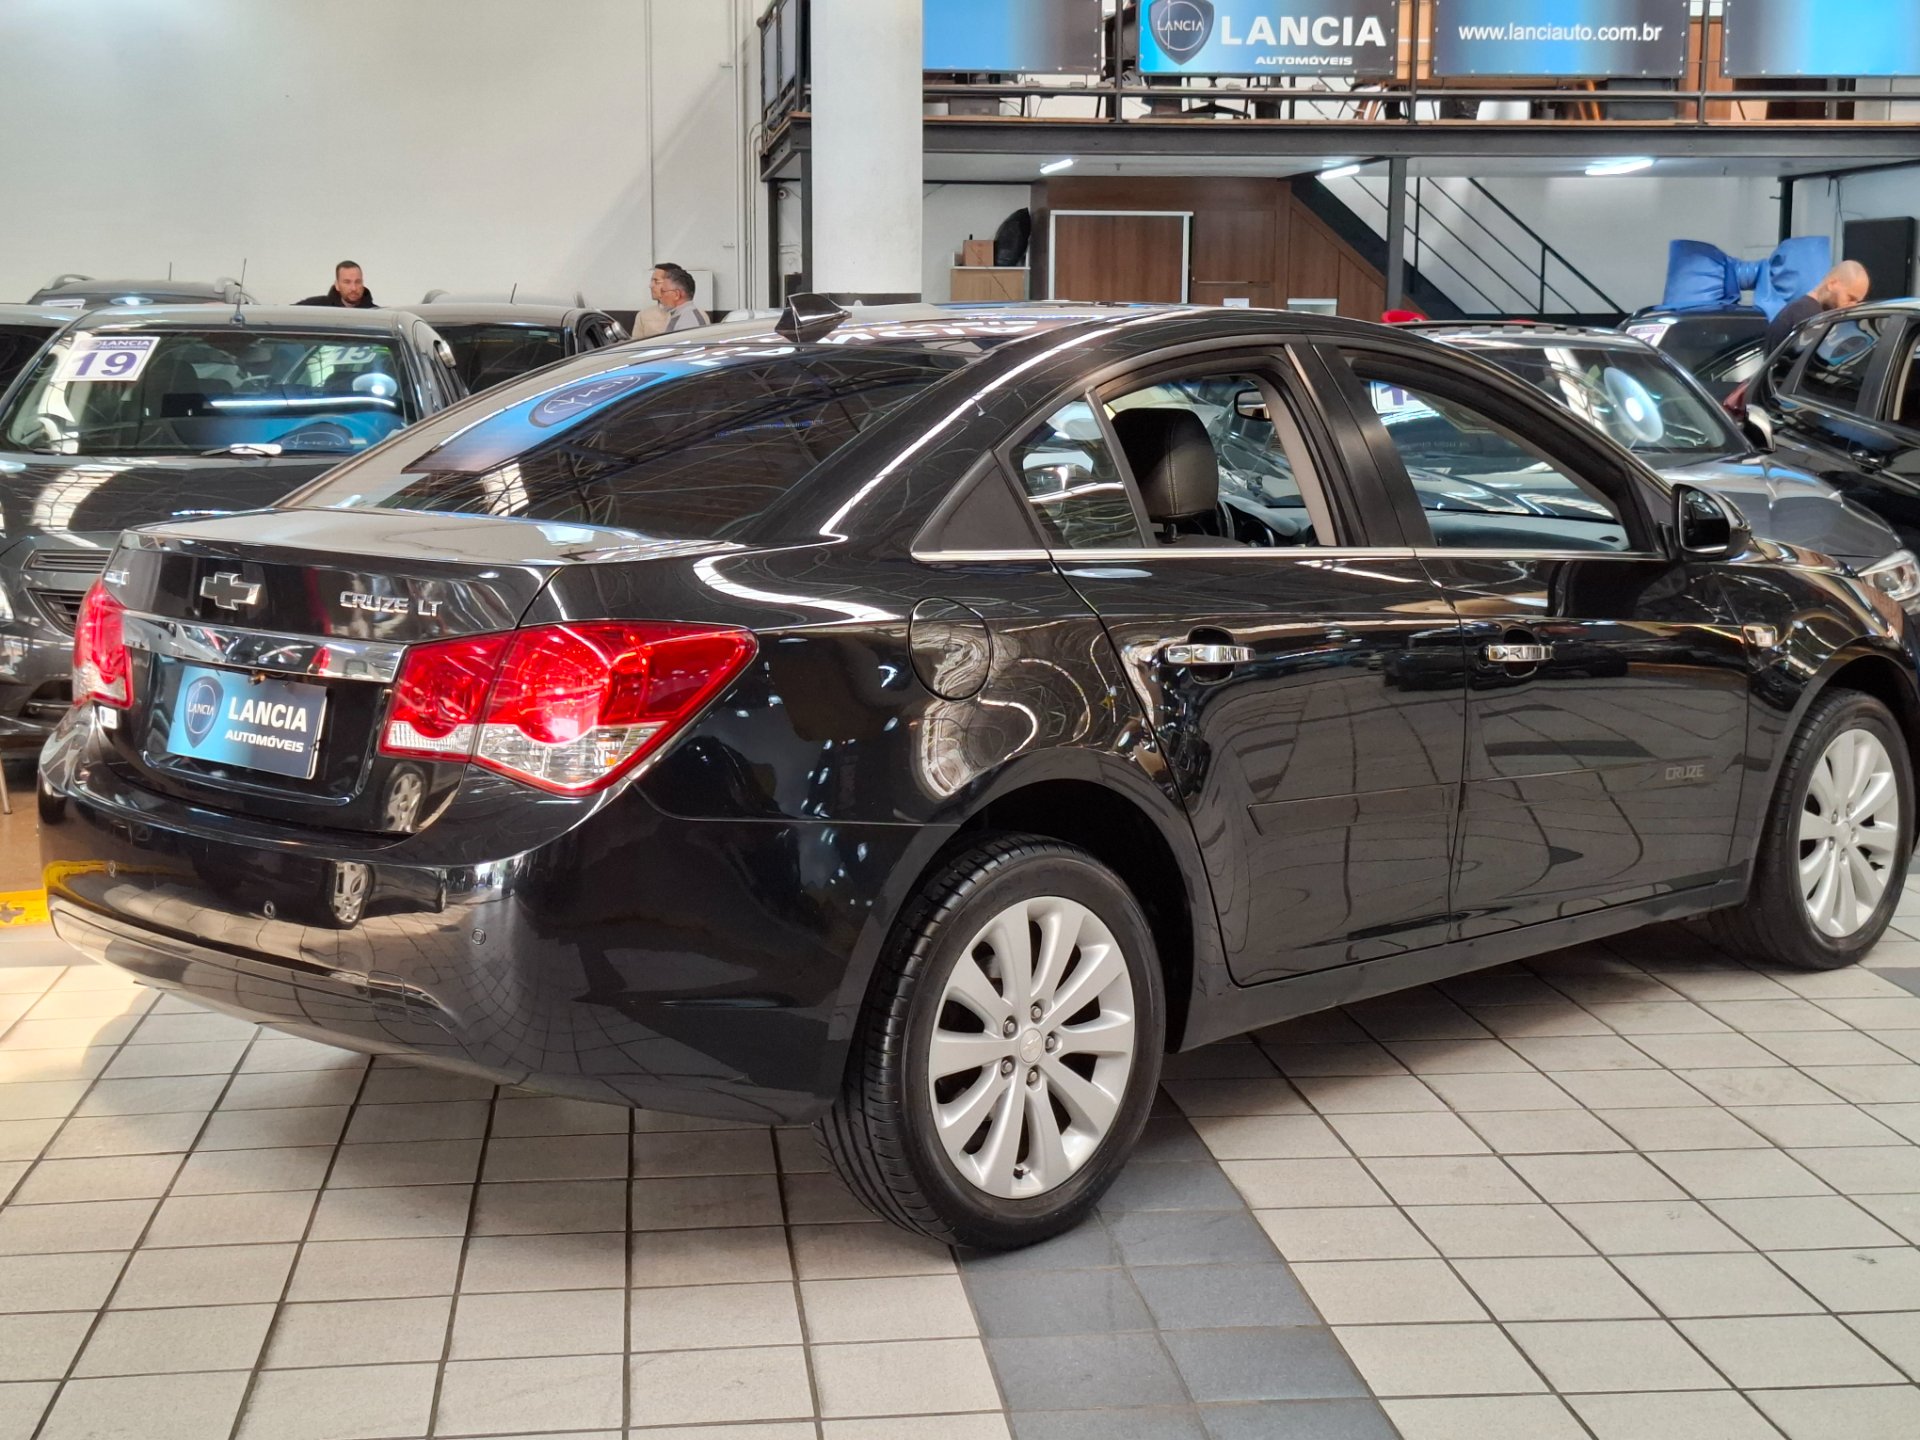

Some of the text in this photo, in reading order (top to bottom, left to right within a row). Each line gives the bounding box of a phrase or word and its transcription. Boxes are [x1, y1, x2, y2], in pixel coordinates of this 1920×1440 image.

[1157, 20, 1204, 31] LANCIA
[1221, 16, 1387, 47] LANCIA
[1458, 22, 1663, 41] www.lanciauto.com.br
[1255, 55, 1353, 66] AUTOMÓVEIS
[74, 351, 137, 376] 19
[340, 591, 443, 617] CRUZE LT
[188, 701, 215, 716] LANCIA
[227, 696, 307, 733] LANCIA
[224, 729, 305, 753] AUTOMÓVEIS
[1665, 764, 1705, 780] CRUZE
